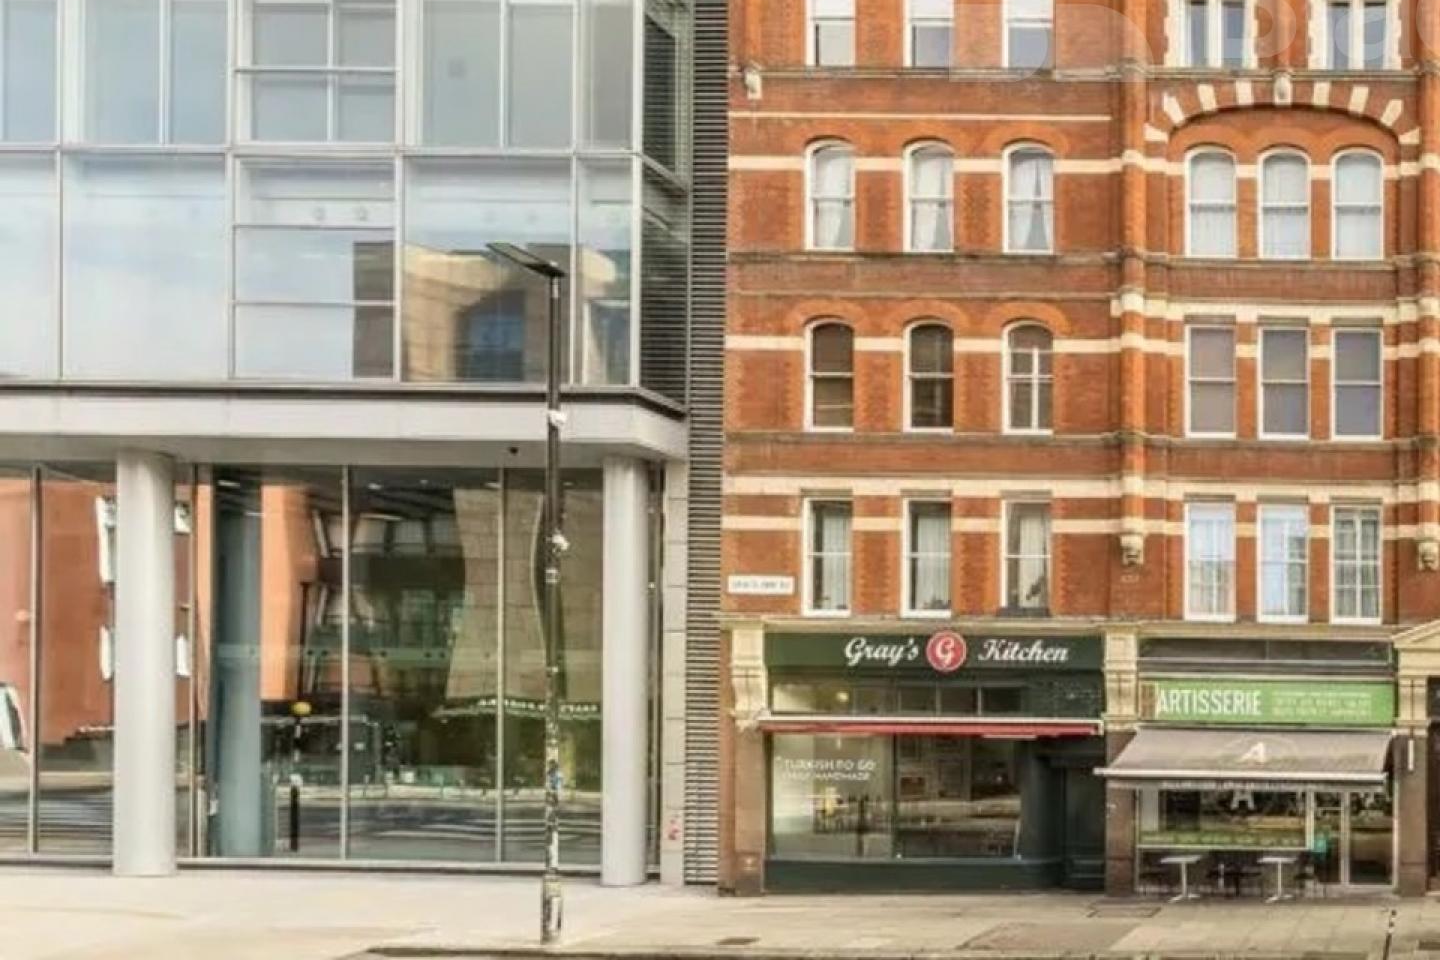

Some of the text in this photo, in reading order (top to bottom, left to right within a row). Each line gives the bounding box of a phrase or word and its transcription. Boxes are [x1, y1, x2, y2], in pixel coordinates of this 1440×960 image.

[844, 636, 920, 667] Gray's
[935, 636, 955, 667] G
[977, 639, 1069, 663] Kitchen
[1158, 689, 1263, 716] ARTISSERIE
[1239, 741, 1267, 764] A
